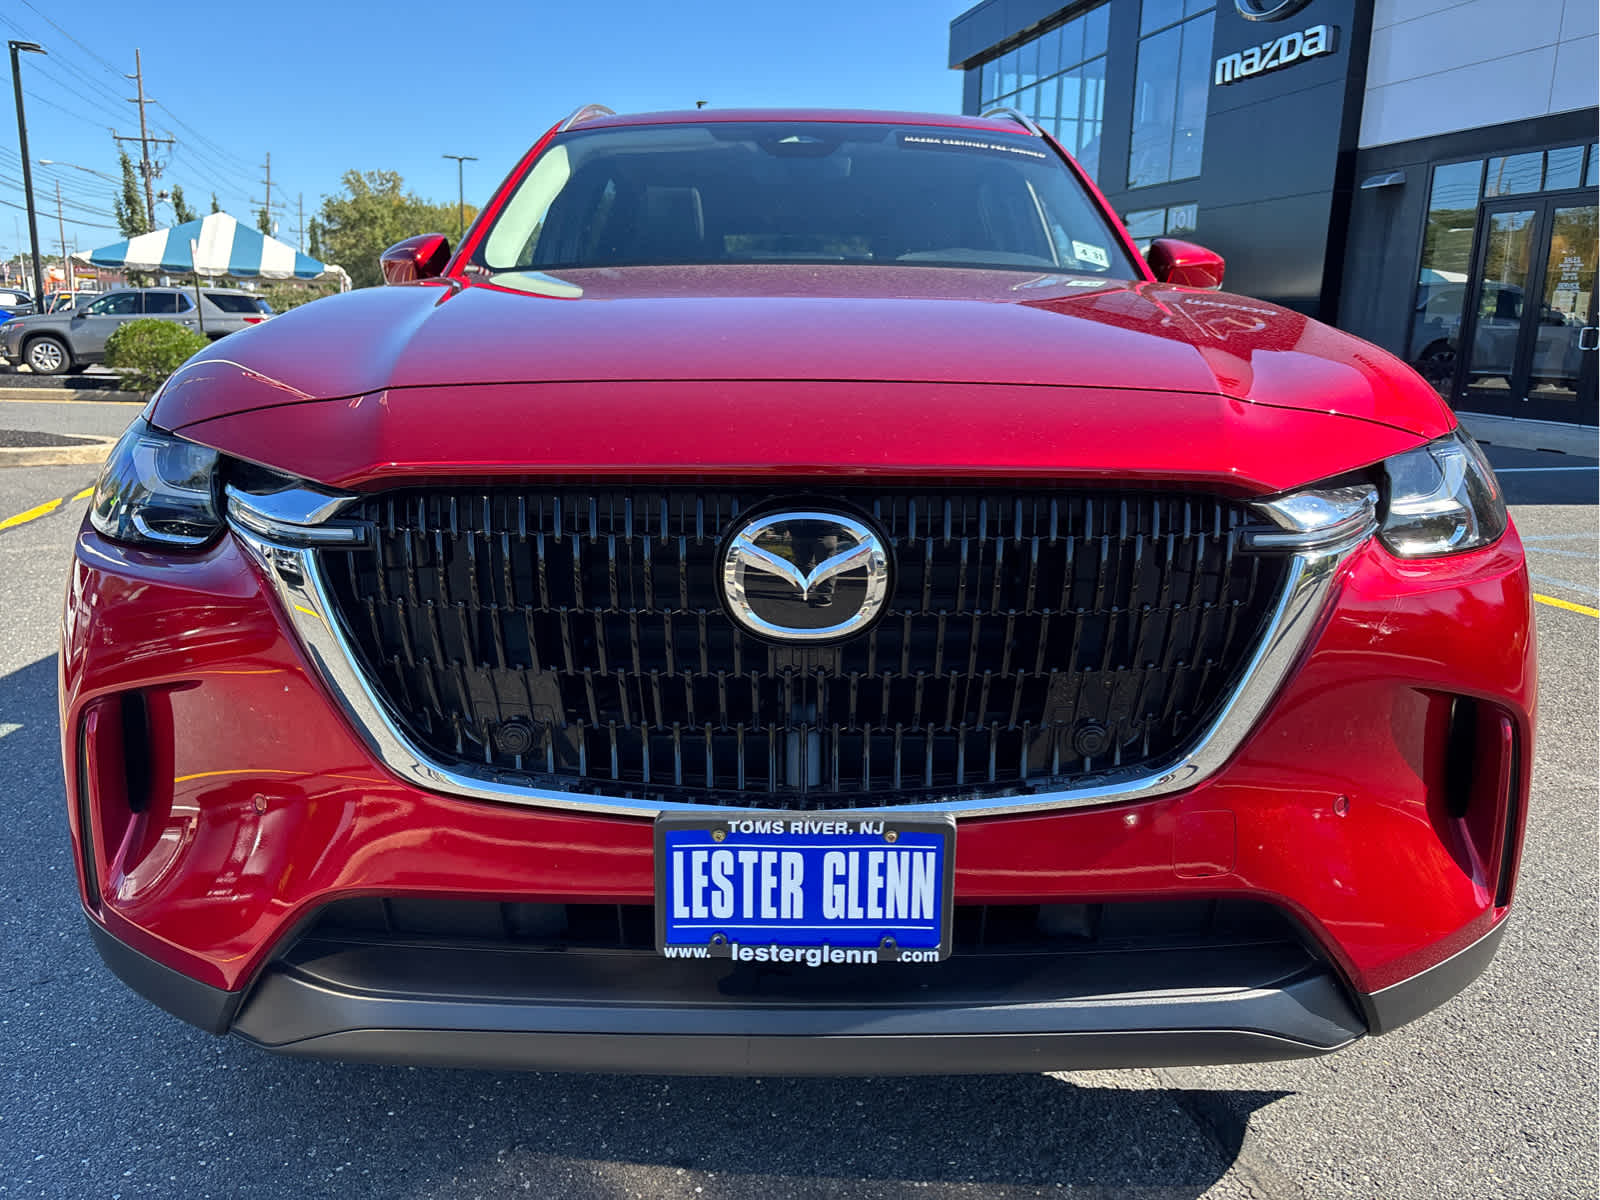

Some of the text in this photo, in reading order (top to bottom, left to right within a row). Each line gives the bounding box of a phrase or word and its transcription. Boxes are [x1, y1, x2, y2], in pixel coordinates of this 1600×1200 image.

[728, 821, 885, 836] TOMS RIVER, NJ
[673, 850, 936, 920] LESTER GLENN
[664, 943, 940, 966] www. lesterglenn .com
